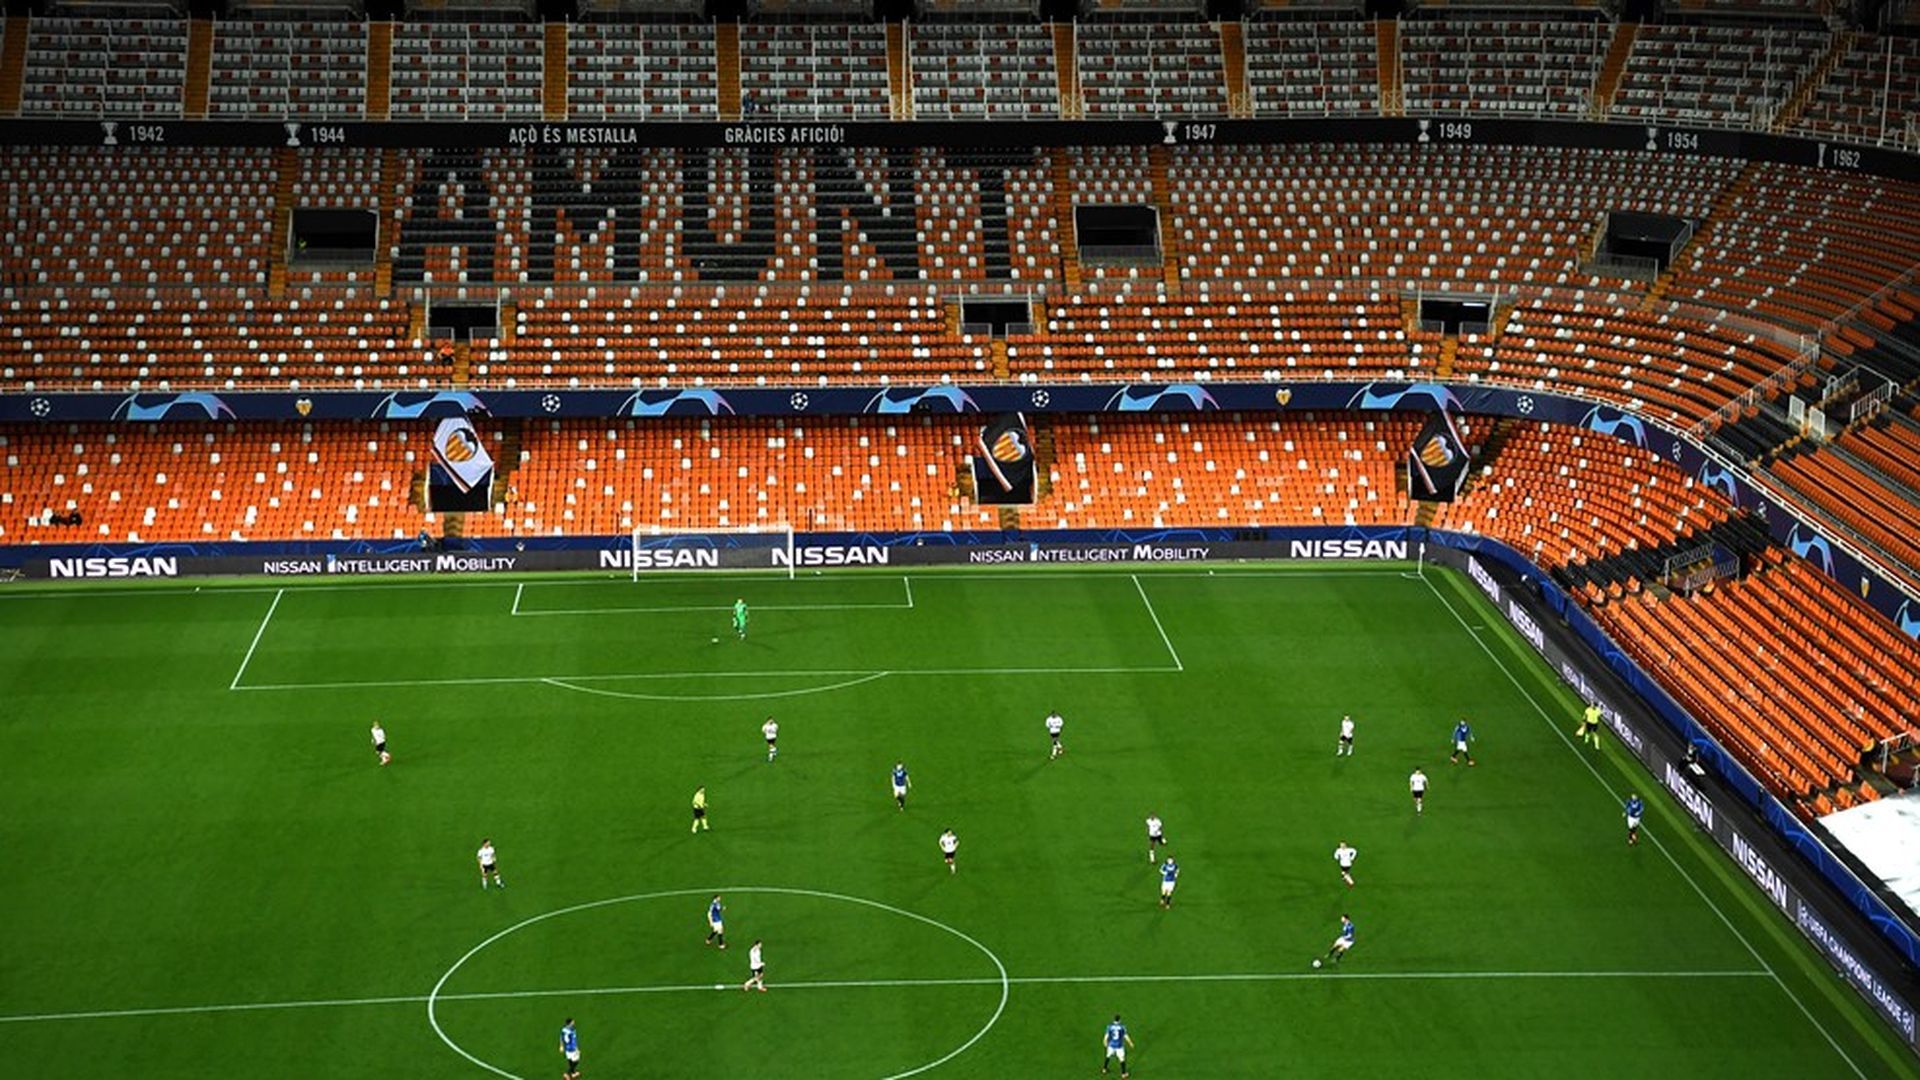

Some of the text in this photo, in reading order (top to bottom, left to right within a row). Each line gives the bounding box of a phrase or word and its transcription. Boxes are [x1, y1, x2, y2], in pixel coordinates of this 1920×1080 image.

[129, 126, 165, 142] 1942
[311, 127, 346, 143] 1944
[508, 124, 638, 147] AÇÒ ÉS MESTALLA
[724, 125, 845, 144] GRÀCIES AFICIÓ!
[1184, 124, 1217, 141] 1947
[1438, 123, 1473, 139] 1949
[1666, 132, 1699, 150] 1954
[1832, 149, 1861, 169] 1962
[600, 548, 718, 568] NISSAN
[773, 546, 889, 566] NISSAN
[969, 550, 1024, 563] NISSAN
[1289, 540, 1407, 559] NISSAN
[49, 556, 178, 578] NISSAN
[263, 561, 322, 574] NISSAN
[1666, 762, 1713, 831] NISSAN
[1732, 832, 1787, 908] NISSAN
[1873, 980, 1902, 1023] LEAGUE
